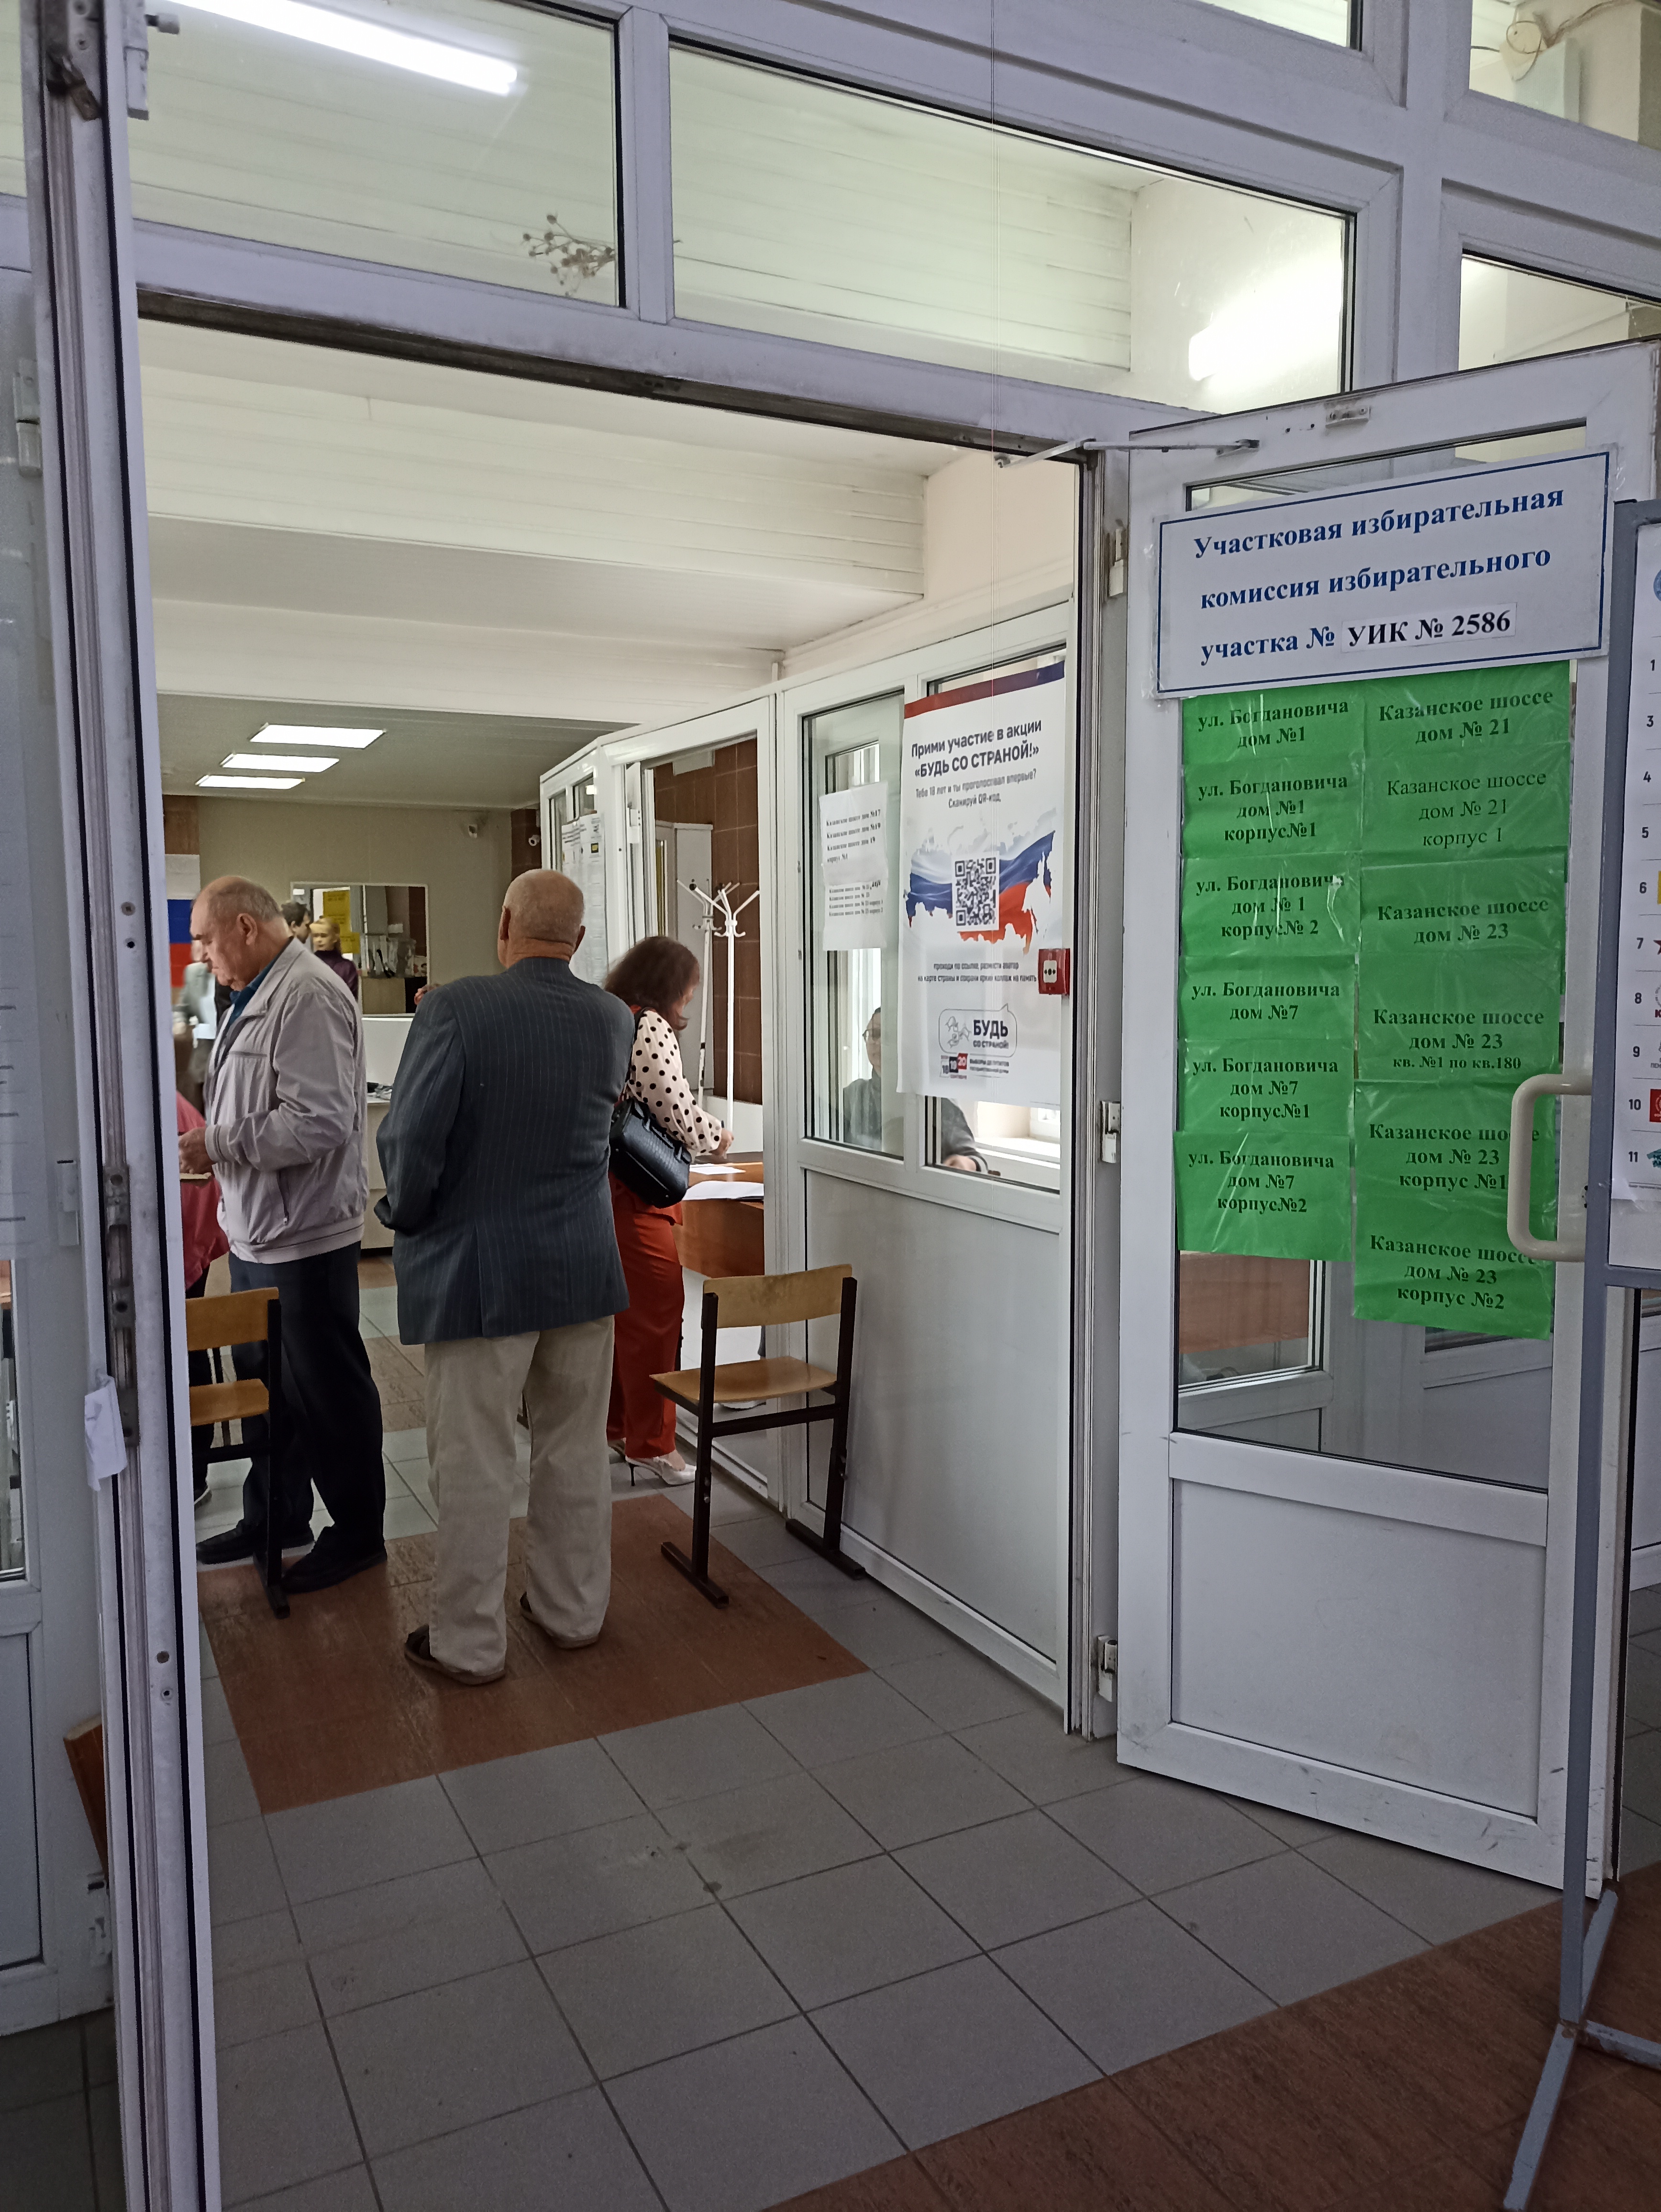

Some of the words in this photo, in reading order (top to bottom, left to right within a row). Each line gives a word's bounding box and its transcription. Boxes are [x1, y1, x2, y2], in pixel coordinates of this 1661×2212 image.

[1194, 523, 1342, 559] Участковая
[1351, 489, 1564, 536] избирательная
[1201, 577, 1319, 609] комиссия
[1329, 550, 1550, 595] избирательного
[1201, 635, 1298, 666] участка
[1307, 625, 1335, 649] №
[1348, 620, 1408, 647] УИК
[1415, 619, 1444, 641] №
[1451, 609, 1510, 636] 2586
[1650, 659, 1655, 671] 1
[1379, 699, 1483, 721] Казанское
[1490, 692, 1552, 709] шоссе
[1198, 715, 1223, 731] ул.
[1230, 702, 1348, 724] Богдановича
[1647, 716, 1654, 728] 3
[912, 741, 945, 759] Прими
[948, 731, 994, 753] участие
[997, 729, 1004, 740] в
[1007, 720, 1041, 738] акции
[1238, 733, 1270, 748] дом
[1277, 727, 1305, 743] №1
[1416, 728, 1452, 744] дом
[1460, 721, 1482, 738] №
[1489, 719, 1509, 735] 21
[915, 760, 949, 777] «БУДЬ
[952, 755, 968, 772] СО
[971, 740, 1039, 768] СТРАНОЙ!»
[1387, 778, 1480, 796] Казанское
[1487, 773, 1546, 788] шоссе
[1643, 772, 1651, 784] 4
[1199, 785, 1223, 800] ул.
[1230, 777, 1347, 795] Богдановича
[949, 795, 976, 808] Сканируй
[1237, 803, 1269, 818] дом
[1276, 799, 1304, 815] №1
[1419, 806, 1453, 820] дом
[1461, 801, 1481, 817] №
[1488, 799, 1506, 814] 21
[1423, 832, 1487, 849] корпус
[1497, 828, 1501, 841] 1
[1642, 827, 1649, 838] 5
[1196, 880, 1220, 896] ул.
[1639, 882, 1647, 894] 6
[1232, 901, 1264, 915] дом
[1271, 897, 1291, 912] №
[1298, 897, 1304, 911] 1
[1378, 903, 1480, 920] Казанское
[1487, 900, 1549, 914] шоссе
[1310, 920, 1318, 934] 2
[1414, 930, 1450, 944] дом
[1458, 925, 1480, 940] №
[1487, 923, 1508, 939] 23
[1637, 938, 1643, 949] 7
[1192, 985, 1216, 1000] ул.
[1223, 982, 1339, 997] Богдановича
[1635, 992, 1642, 1004] 8
[1230, 1007, 1262, 1019] дом
[1268, 1005, 1298, 1019] №7
[1374, 1009, 1475, 1024] Казанское
[1483, 1011, 1544, 1024] шоссе
[974, 1020, 1008, 1040] БУДЬ
[1409, 1036, 1445, 1050] дом
[1452, 1034, 1474, 1049] №
[1482, 1034, 1502, 1049] 23
[1633, 1046, 1640, 1057] 9
[958, 1057, 966, 1066] 20
[1193, 1061, 1216, 1075] ул.
[1223, 1058, 1338, 1073] Богдановича
[1394, 1057, 1415, 1068] кв.
[1419, 1056, 1442, 1068] №1
[1450, 1059, 1467, 1068] по
[1473, 1057, 1521, 1069] кв.180
[1230, 1084, 1262, 1095] дом
[1269, 1081, 1298, 1095] №7
[1629, 1099, 1641, 1110] 10
[1370, 1124, 1472, 1140] Казанское
[1479, 1128, 1539, 1140] шое
[1189, 1153, 1213, 1167] ул.
[1220, 1150, 1334, 1168] Богдановича
[1406, 1152, 1442, 1164] дом
[1449, 1149, 1471, 1164] №
[1478, 1150, 1499, 1165] 23
[1628, 1151, 1638, 1162] 11
[1228, 1176, 1260, 1188] дом
[1266, 1174, 1294, 1189] №7
[1400, 1175, 1468, 1192] корпус
[1474, 1174, 1506, 1189] №1
[1371, 1235, 1471, 1258] Казанское
[1404, 1265, 1440, 1279] дом
[1447, 1266, 1469, 1282] №
[1476, 1269, 1497, 1284] 23
[1397, 1288, 1465, 1307] корпус
[1471, 1291, 1504, 1309] №2
